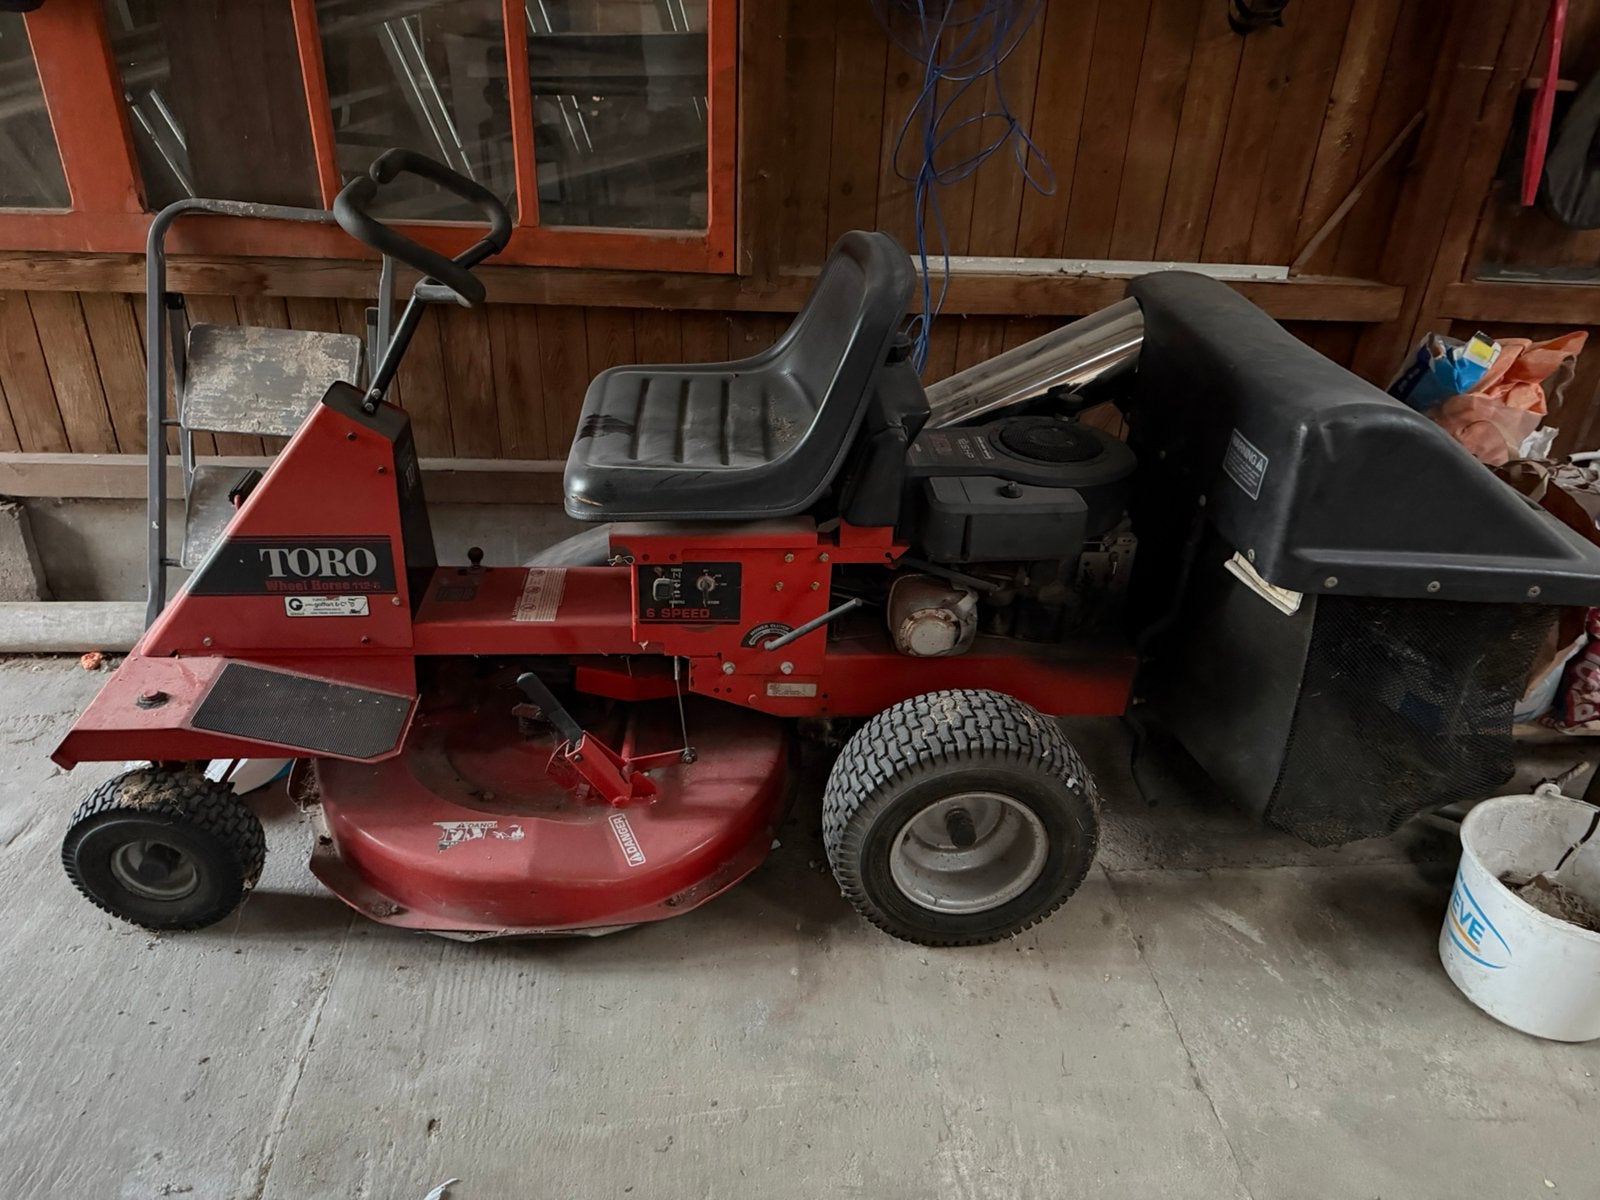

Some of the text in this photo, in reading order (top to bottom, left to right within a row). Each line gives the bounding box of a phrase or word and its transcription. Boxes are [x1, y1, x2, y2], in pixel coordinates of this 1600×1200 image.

[259, 547, 377, 577] TORO
[264, 580, 309, 592] Wheel
[311, 579, 350, 591] Horse
[646, 608, 710, 618] 6 SPEED
[615, 815, 638, 854] DANGER
[1452, 888, 1485, 945] EVE
